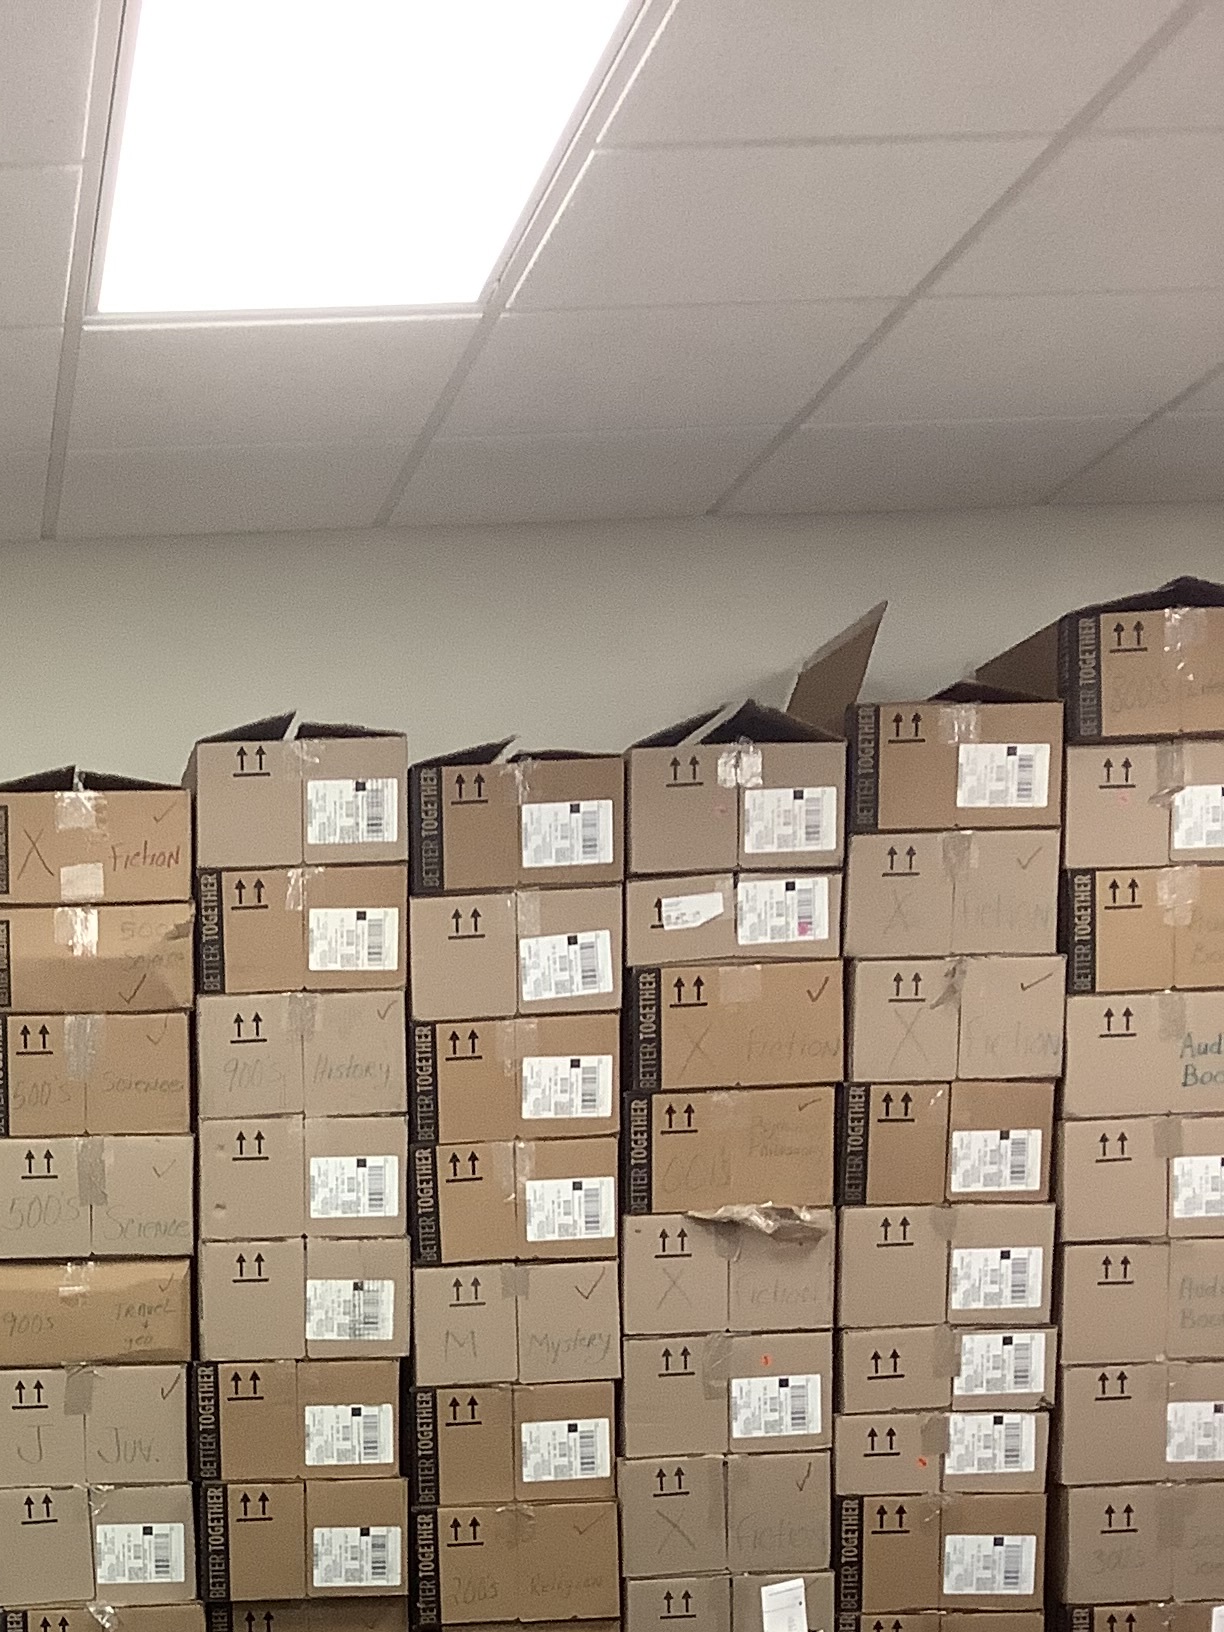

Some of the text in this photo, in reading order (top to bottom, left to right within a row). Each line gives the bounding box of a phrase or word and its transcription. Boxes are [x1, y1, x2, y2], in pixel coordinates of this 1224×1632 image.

[201, 874, 217, 939] TOGETHER
[1074, 875, 1091, 941] TOGETHER
[417, 1026, 432, 1092] TOGETHER
[1180, 1032, 1223, 1059] Aud
[1181, 1064, 1224, 1088] Boo
[631, 1100, 649, 1163] TOGETHER
[846, 1087, 865, 1150] TOGETHER
[417, 1148, 432, 1214] TOGETHER
[198, 1367, 214, 1429] TOGETHER
[417, 1392, 434, 1455] TOGETHER
[210, 1488, 224, 1550] TOGETHER
[418, 1515, 434, 1578] TOGETHER
[842, 1501, 859, 1568] TOGETHER
